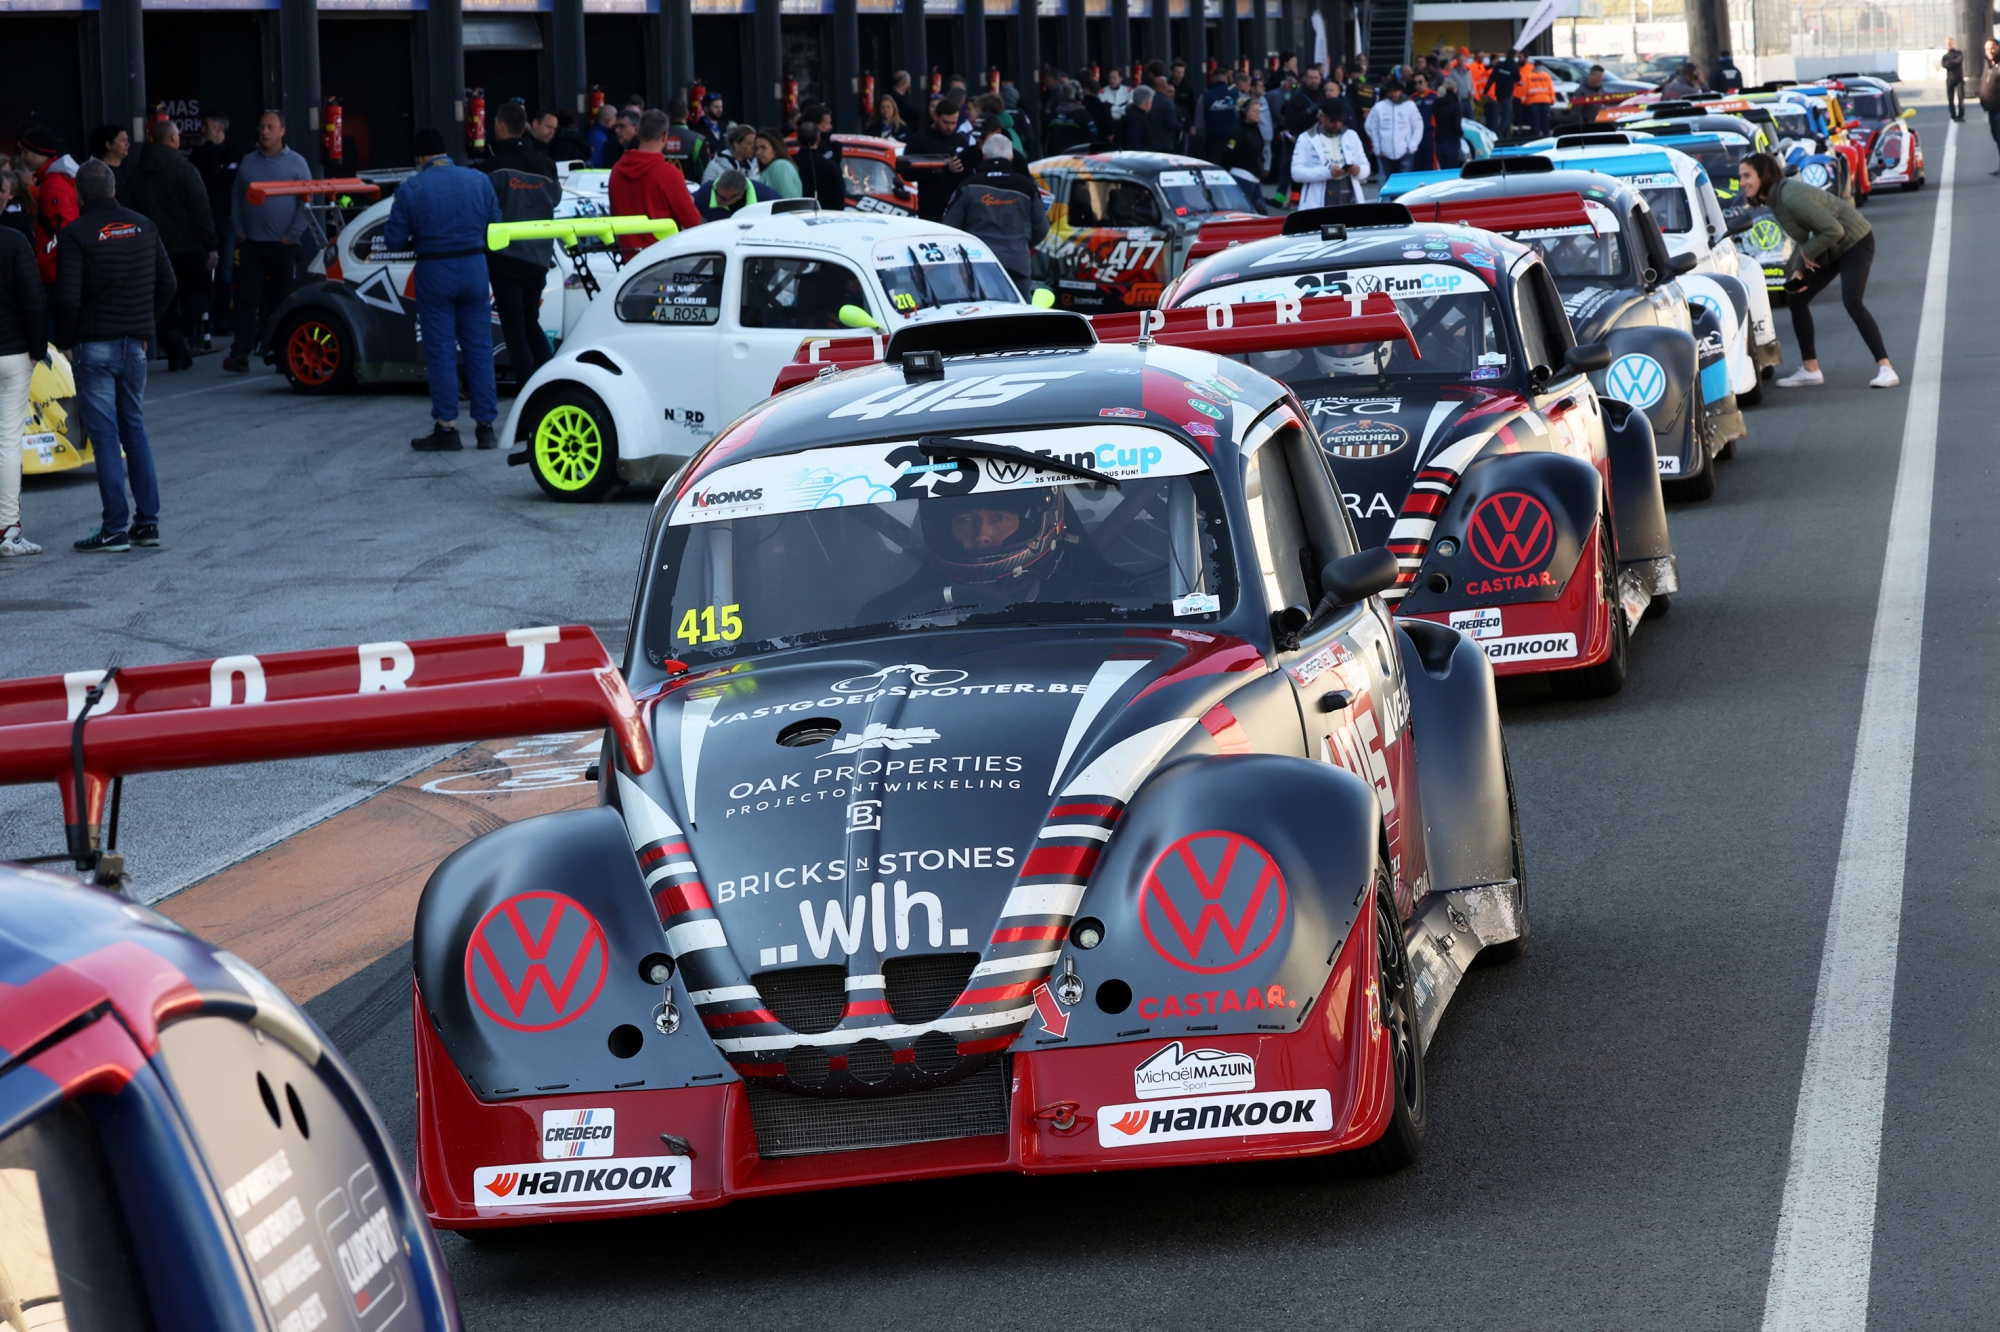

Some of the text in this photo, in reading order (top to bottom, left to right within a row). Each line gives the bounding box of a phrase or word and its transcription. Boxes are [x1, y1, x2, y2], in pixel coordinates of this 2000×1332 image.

[1631, 175, 1676, 185] FunCup
[1750, 219, 1782, 250] VW
[919, 242, 945, 262] 25
[1108, 241, 1164, 270] 477
[1385, 273, 1462, 292] FunCup
[658, 308, 707, 320] A. ROSA
[893, 293, 916, 310] 278
[828, 371, 1088, 421] 415
[1606, 353, 1666, 409] VW
[1327, 433, 1400, 443] PETROLHEAD
[884, 445, 980, 500] 25
[911, 462, 955, 473] ANNIVERSARY
[1034, 443, 1162, 474] FunCup
[1046, 474, 1071, 482] YEARS
[692, 487, 762, 507] KRONOS
[1467, 491, 1554, 573] VW
[1466, 571, 1557, 596] CASTAAR.
[676, 603, 743, 645] 415
[1452, 617, 1500, 630] CREDECO
[708, 683, 1089, 728] VASTGOEDSPOTTER.BE
[728, 755, 1023, 800] OAK PROPERTIES
[726, 779, 1021, 818] PROJECTONTWIKKELING
[718, 860, 846, 904] BRICKS
[878, 846, 1015, 875] STONES
[1138, 829, 1288, 974] VW
[465, 890, 610, 1032] VW
[1137, 984, 1297, 1020] CASTAAR.
[1182, 1081, 1207, 1092] Sport
[545, 1125, 612, 1142] CREDECO
